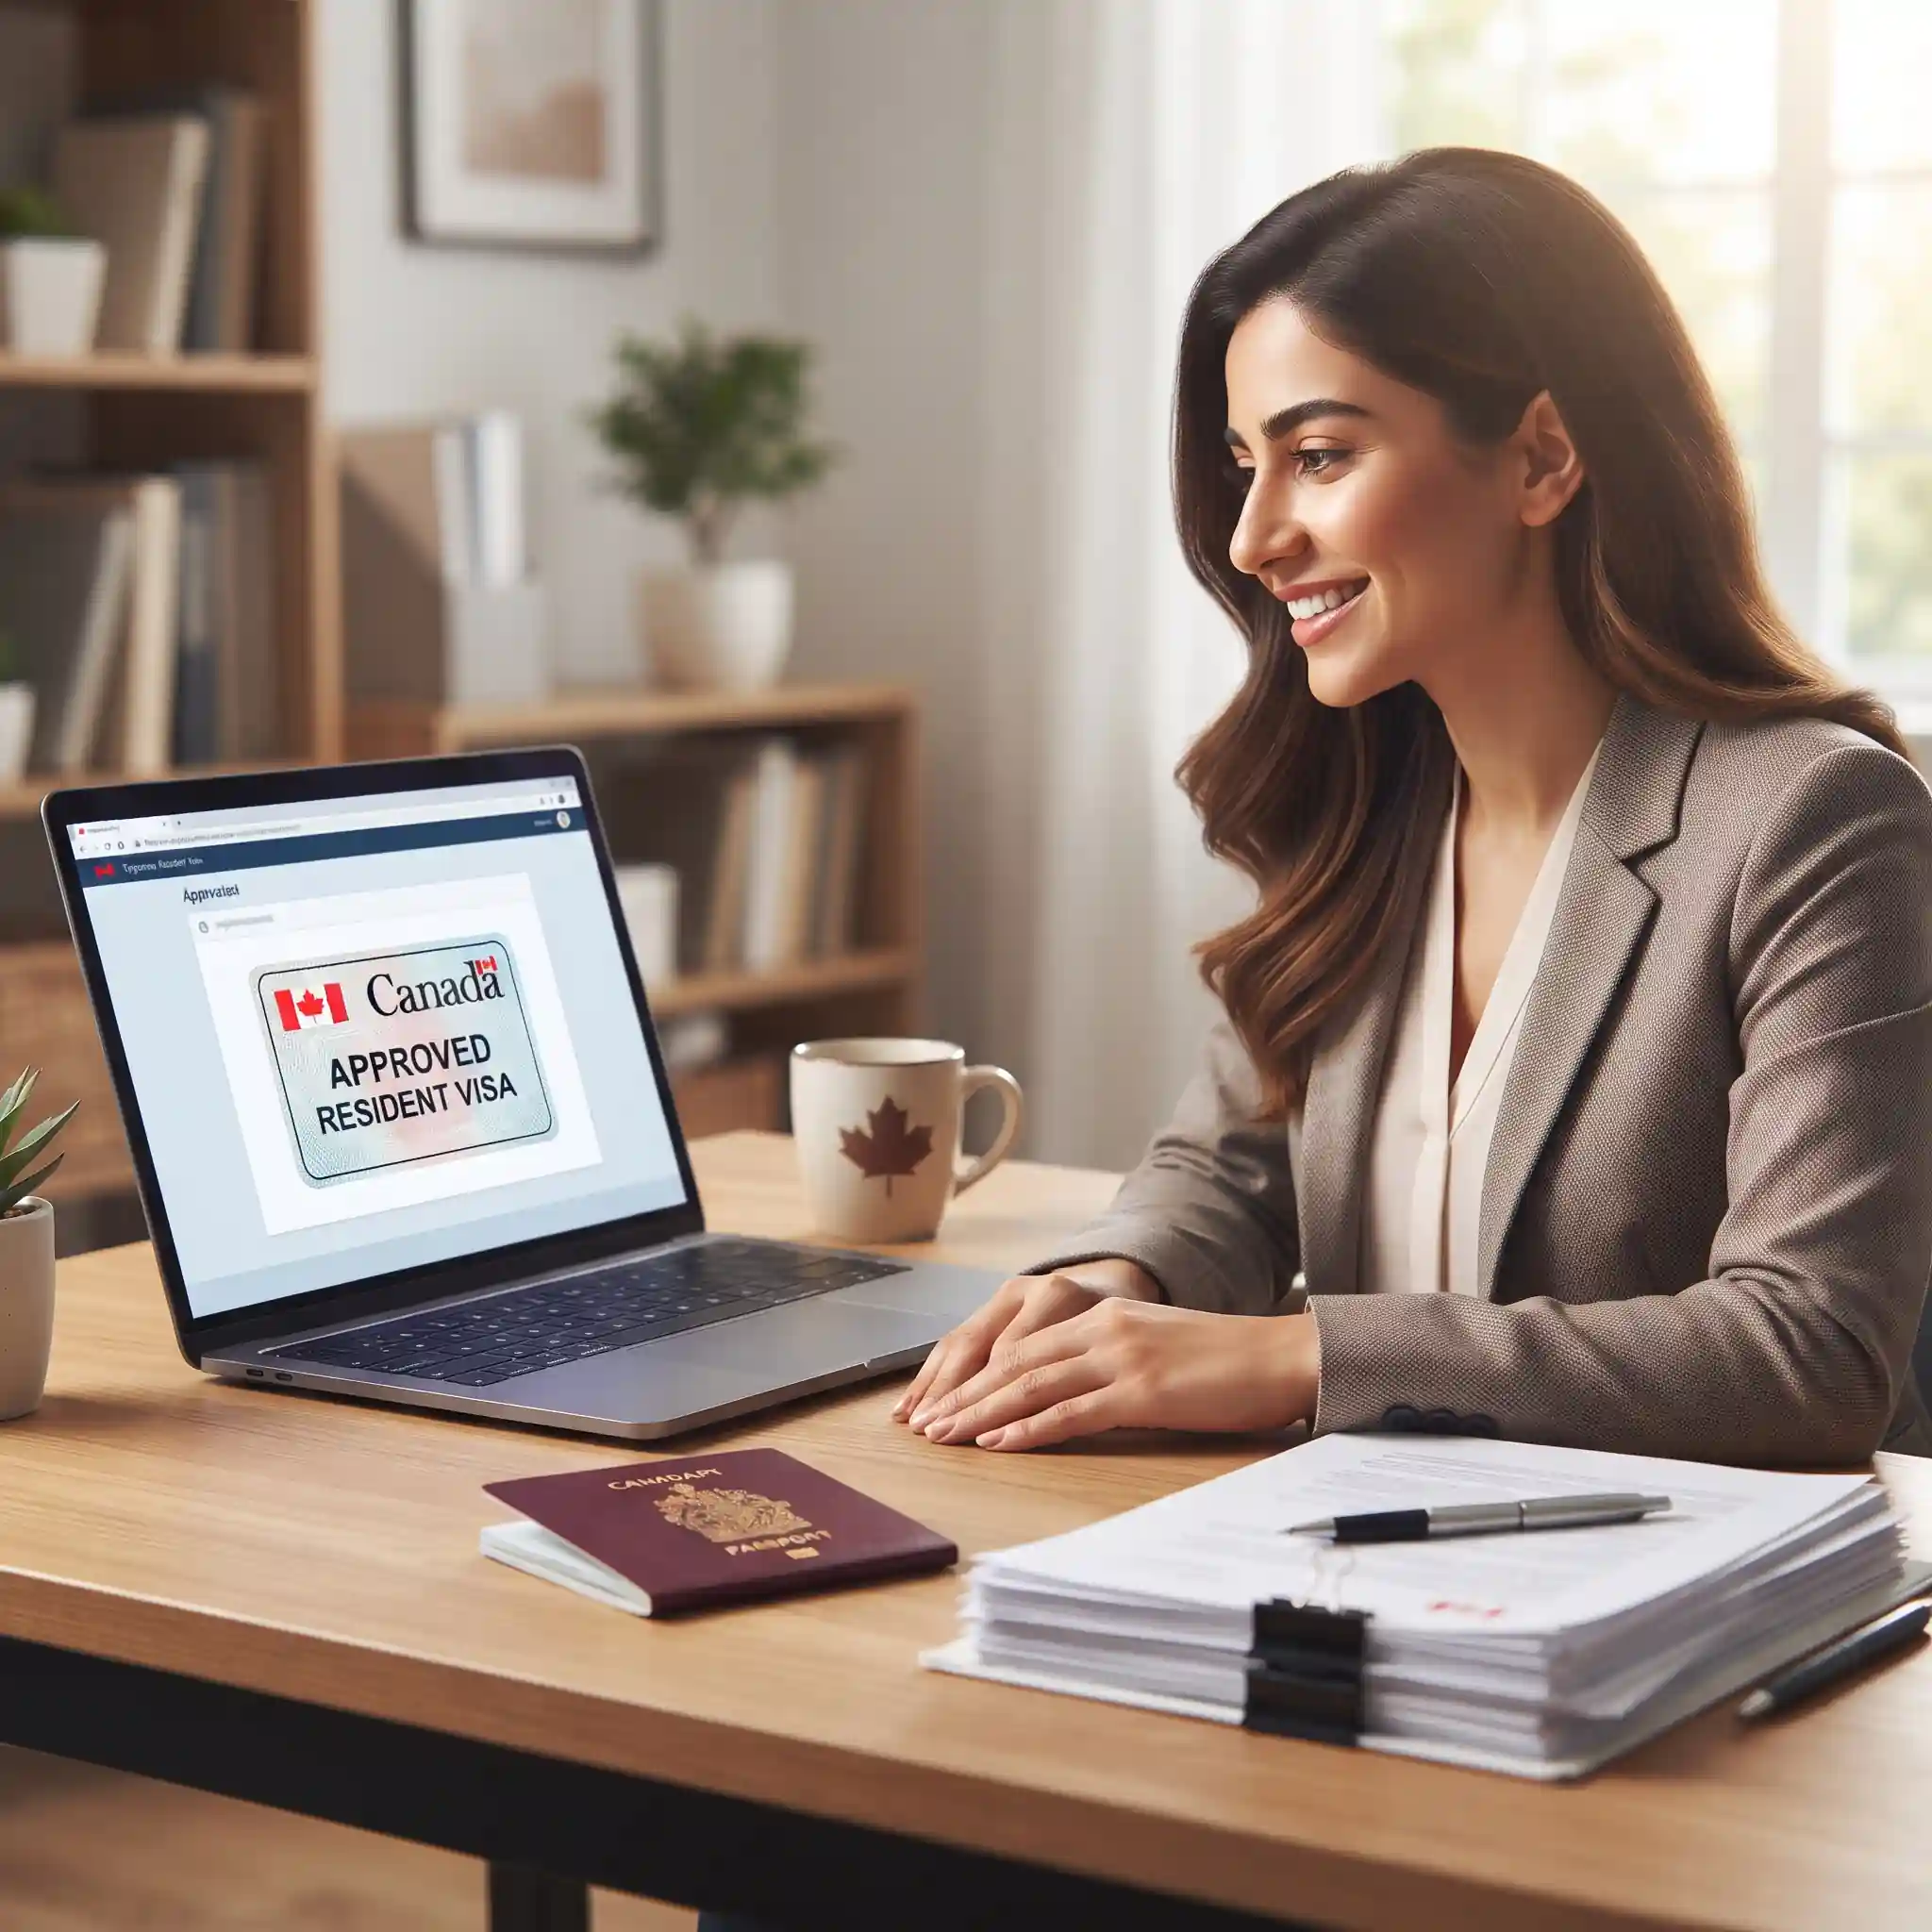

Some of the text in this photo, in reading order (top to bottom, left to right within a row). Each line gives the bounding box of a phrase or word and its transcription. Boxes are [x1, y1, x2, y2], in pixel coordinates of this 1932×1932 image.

[367, 960, 506, 1017] Canada
[331, 1034, 491, 1090] APPROVED
[316, 1072, 518, 1135] RESIDENT VISA
[724, 1530, 832, 1556] PAPORT
